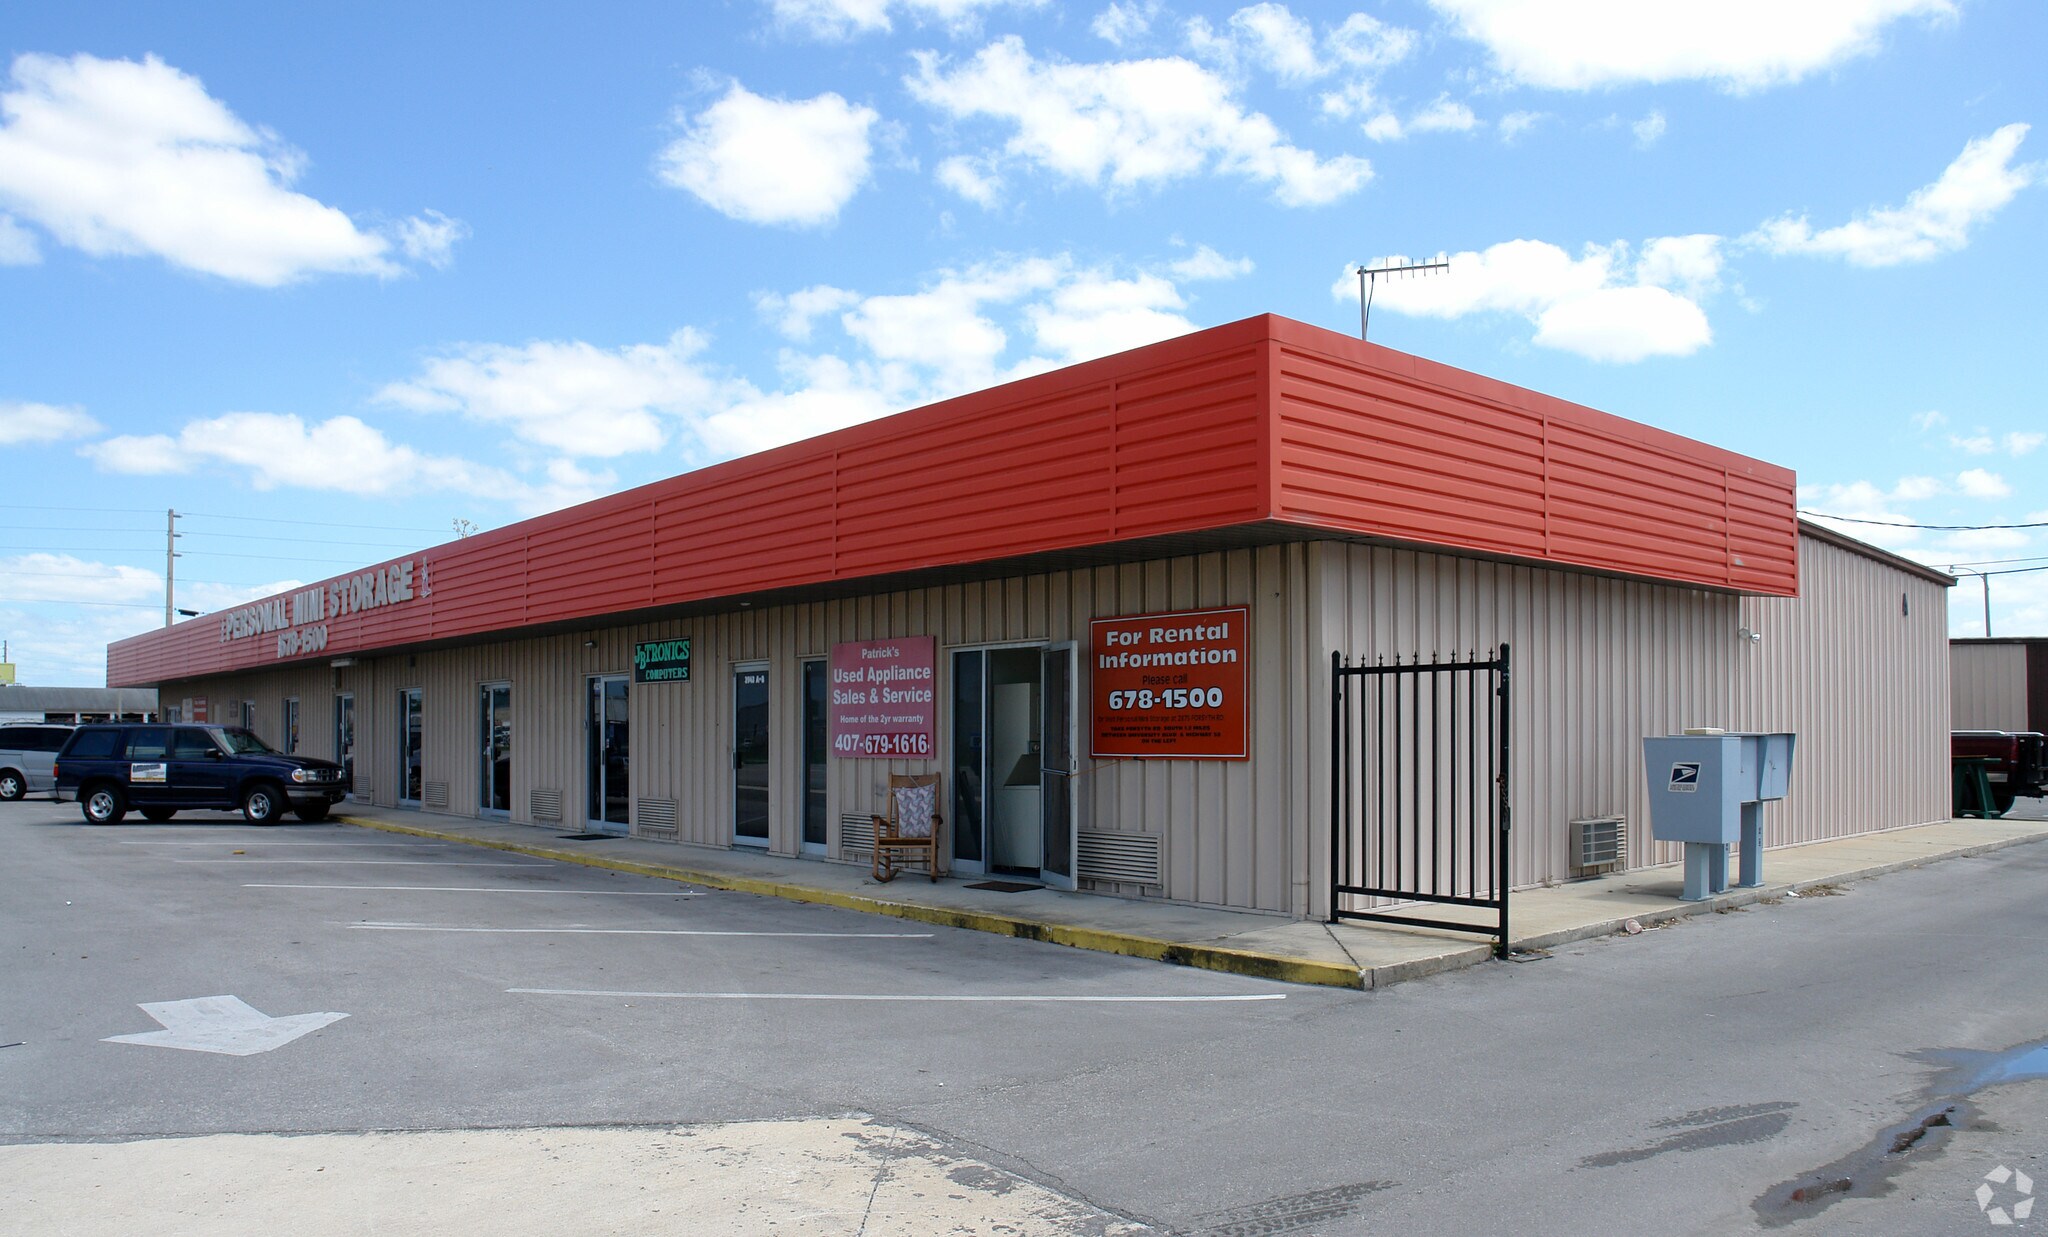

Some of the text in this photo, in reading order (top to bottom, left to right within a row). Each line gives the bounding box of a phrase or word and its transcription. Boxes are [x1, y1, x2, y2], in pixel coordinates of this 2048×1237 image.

[225, 561, 414, 641] PERSONAL MINI STORAGE
[1106, 622, 1229, 646] For Rental
[861, 646, 900, 660] Patrick's
[1099, 647, 1237, 669] Information
[645, 667, 688, 680] COMPUTERS
[833, 665, 931, 685] Used Appliance
[1142, 673, 1188, 686] Please call
[833, 687, 932, 705] Sales & Service
[1108, 687, 1224, 710] 678-1500
[840, 714, 924, 725] Home of the 2yr warranty
[835, 734, 928, 754] 407-679-1616
